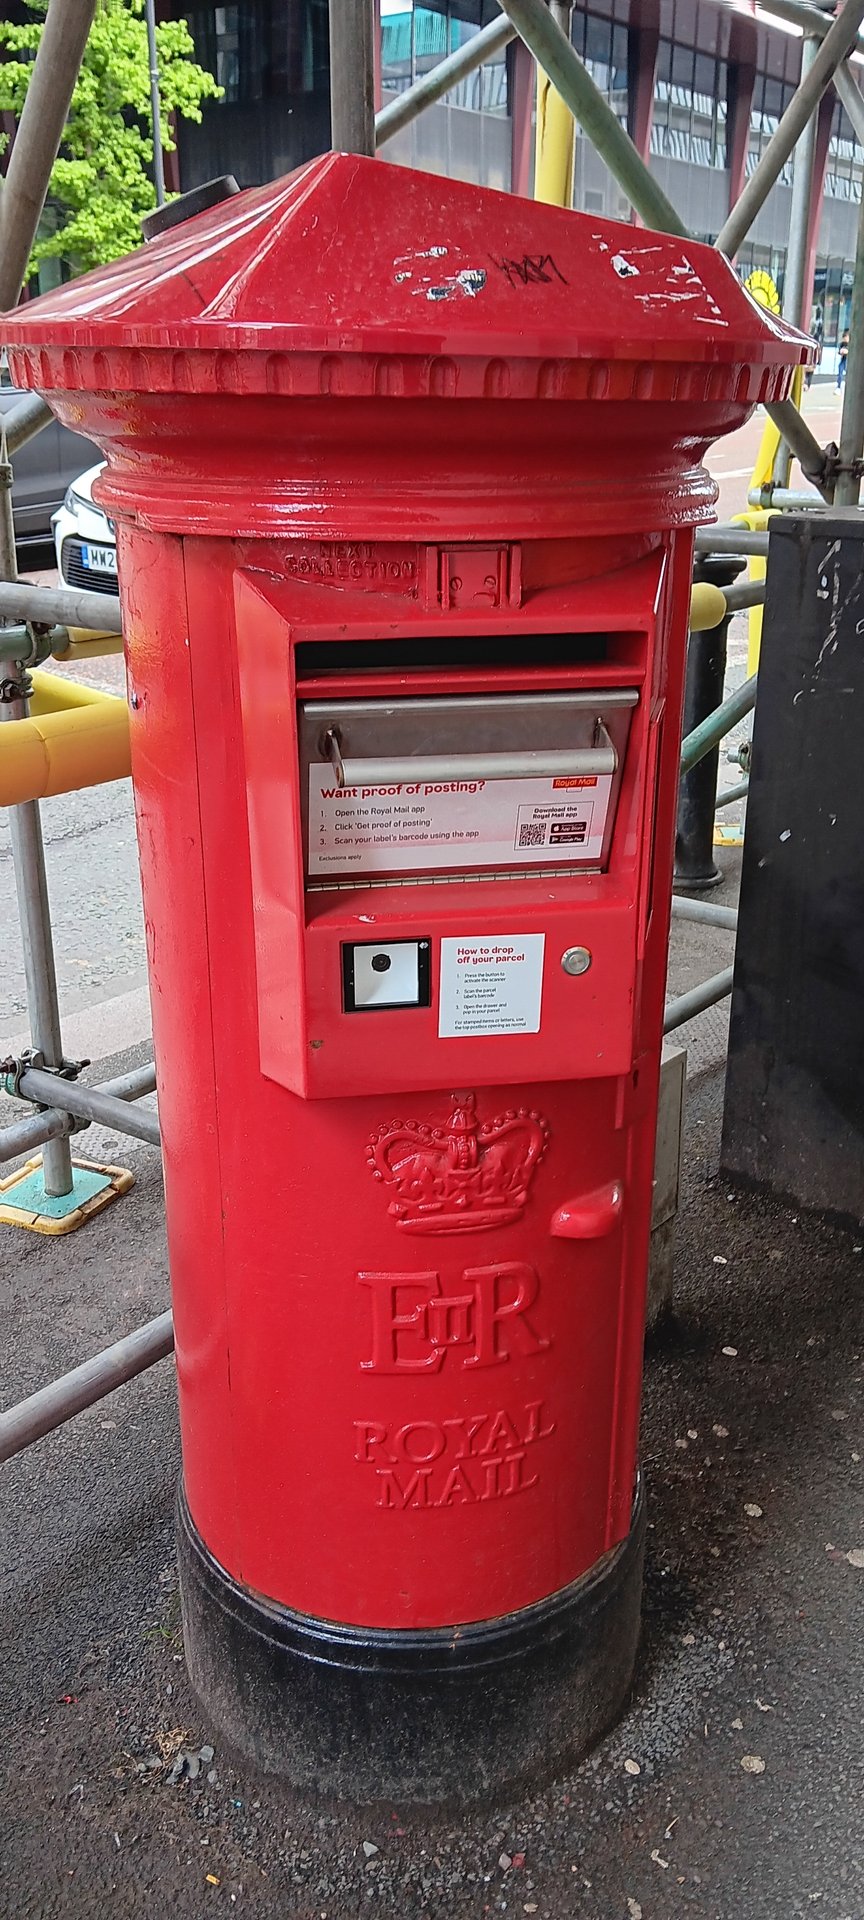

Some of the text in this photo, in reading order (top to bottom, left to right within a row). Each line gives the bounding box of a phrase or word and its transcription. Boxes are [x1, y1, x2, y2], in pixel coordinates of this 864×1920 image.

[320, 541, 377, 558] NEXT
[284, 554, 416, 580] COLLECTION
[320, 780, 486, 799] Want proof of posting?
[555, 777, 596, 788] Royal Mail
[320, 806, 426, 818] 1. Open the Royal Mail app
[334, 823, 353, 831] Click
[371, 821, 392, 831] proof
[393, 820, 401, 828] of
[319, 830, 479, 846] 3. Scan your label's barcode using the app
[457, 946, 514, 956] How to drop
[457, 954, 525, 965] off your parcel
[353, 1401, 557, 1464] ROYAL
[375, 1452, 539, 1510] MAIL
